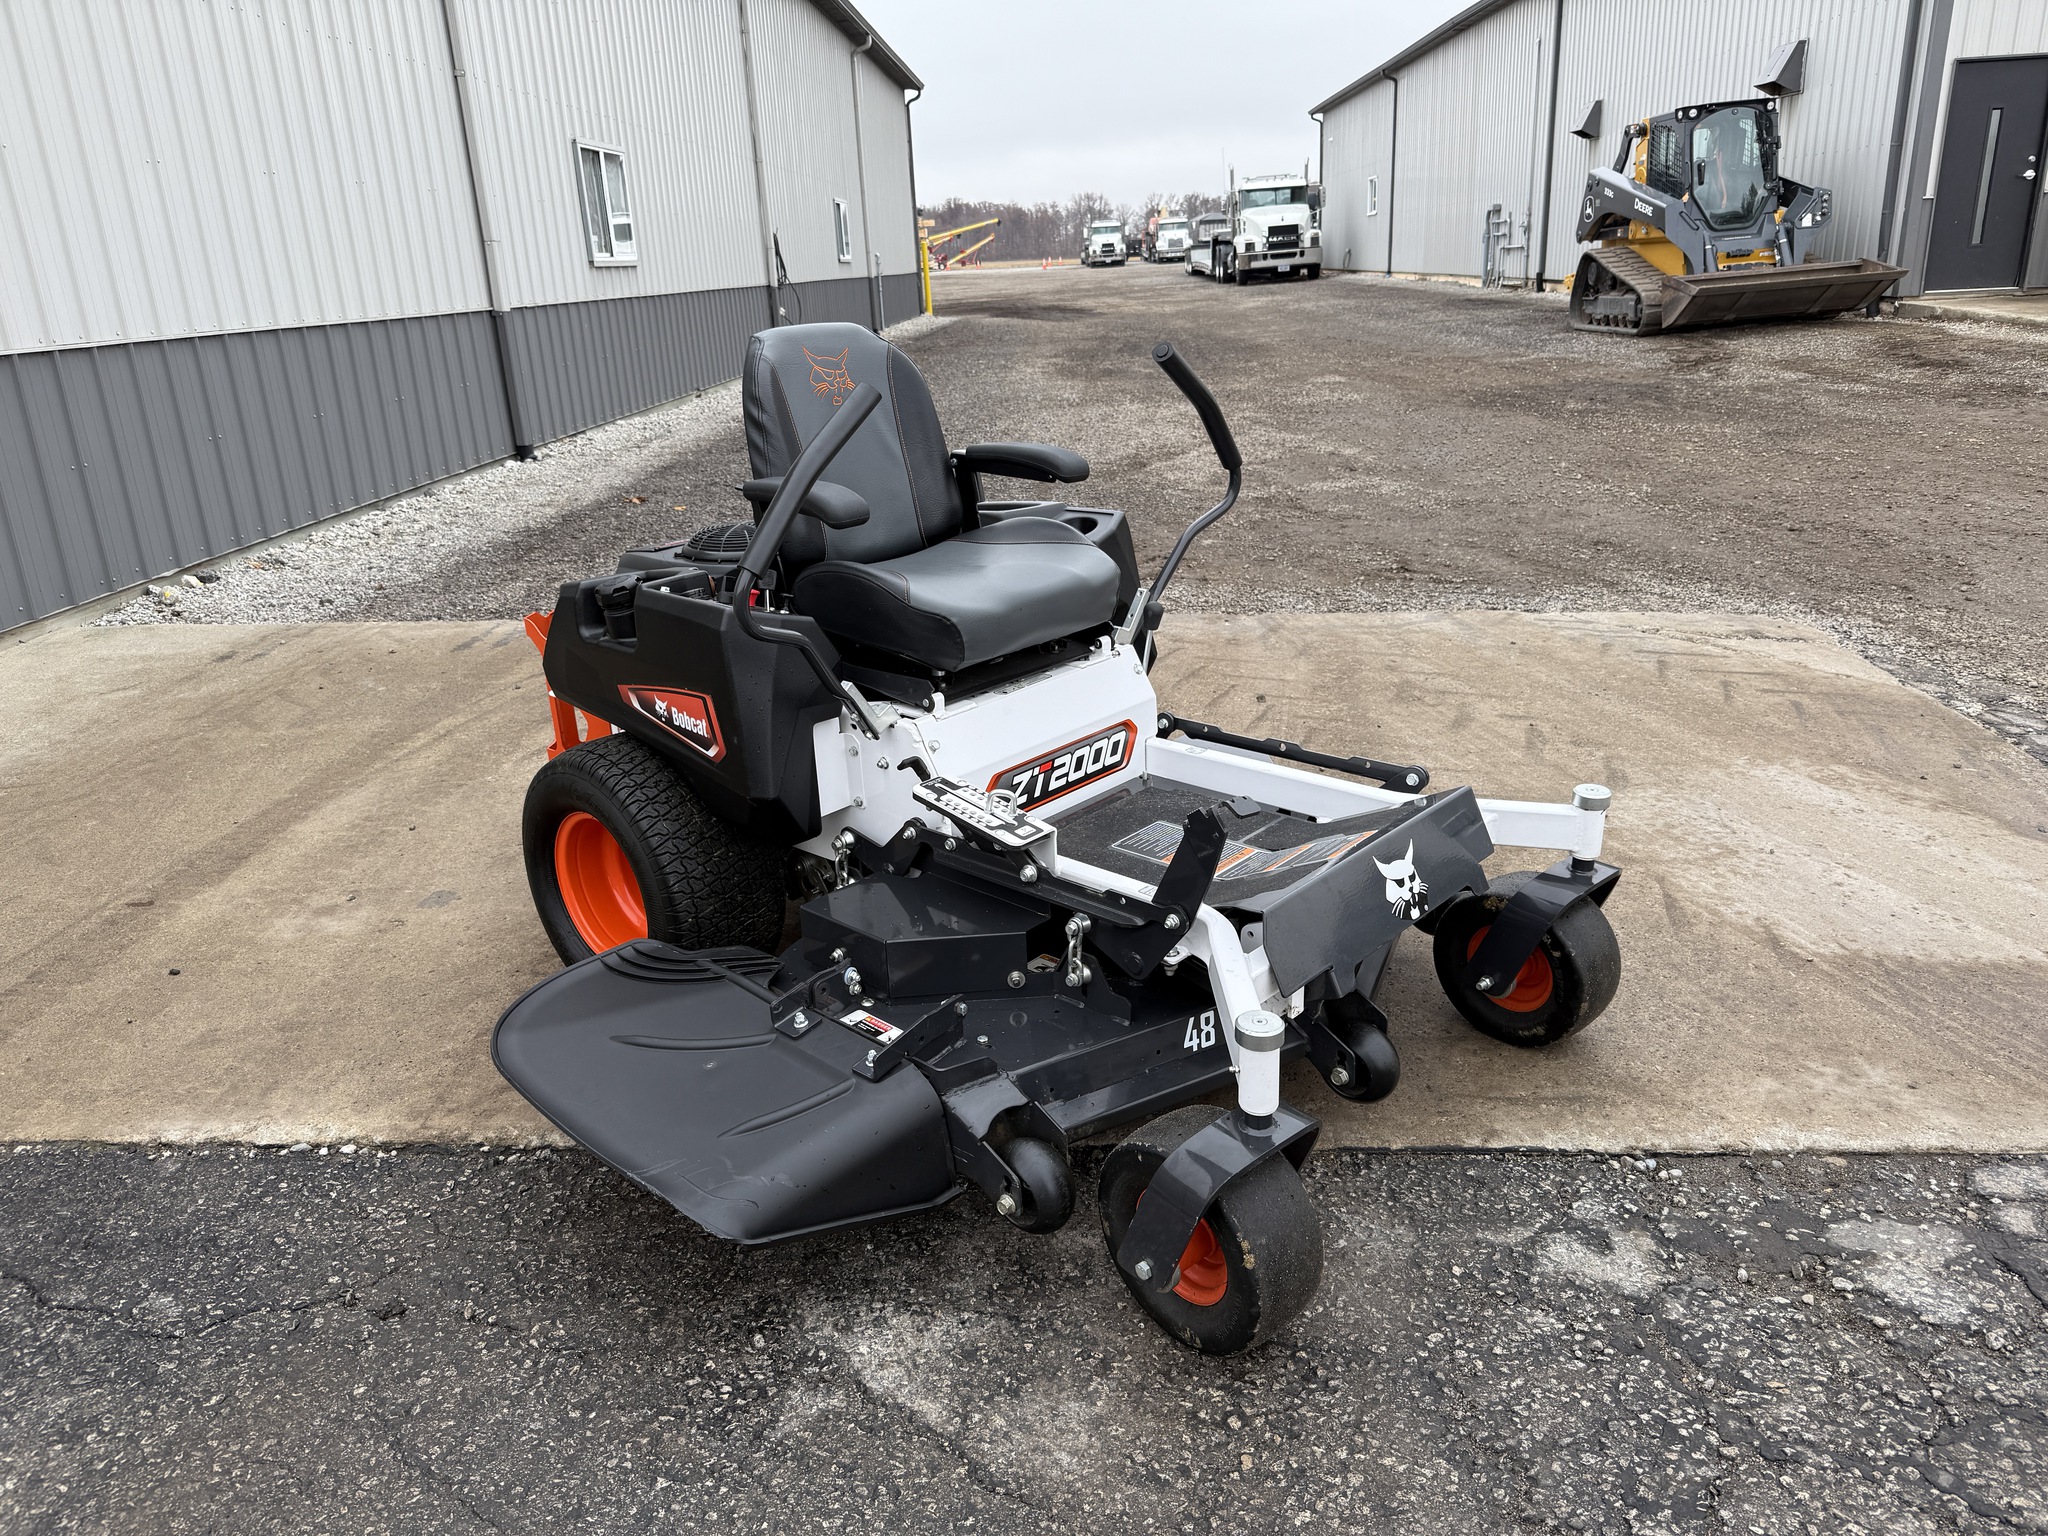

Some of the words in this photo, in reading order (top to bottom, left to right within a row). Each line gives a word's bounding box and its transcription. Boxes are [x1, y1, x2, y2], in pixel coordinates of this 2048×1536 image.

[1634, 198, 1653, 216] DEERE
[671, 706, 708, 738] Bobcat
[1012, 730, 1127, 806] ZT2000
[1183, 1010, 1216, 1052] 48
